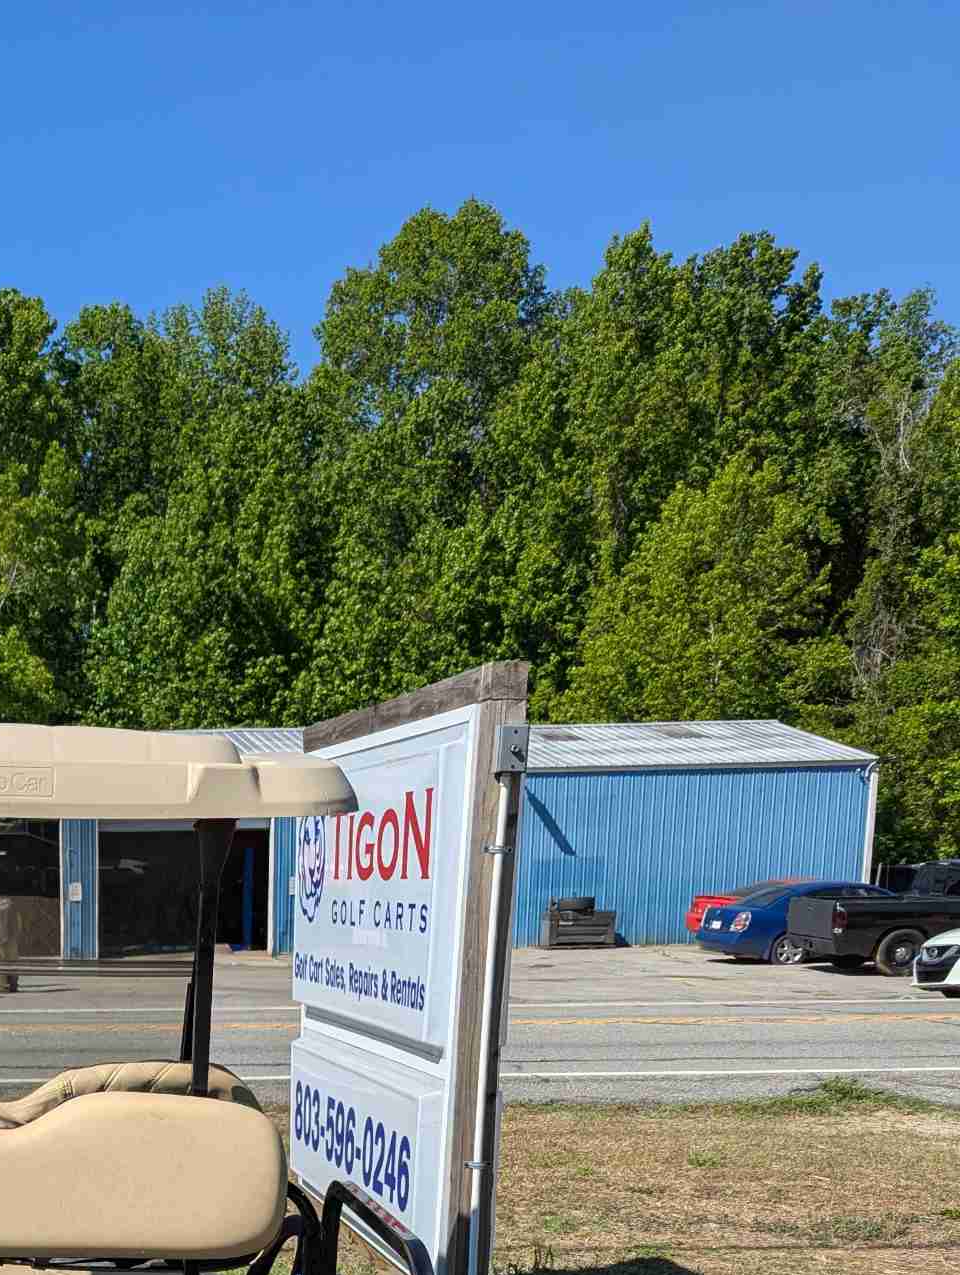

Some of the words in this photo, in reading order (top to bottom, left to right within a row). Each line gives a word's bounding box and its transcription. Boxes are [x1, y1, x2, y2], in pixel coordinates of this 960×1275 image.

[11, 771, 48, 793] Car
[332, 787, 434, 881] TIGON
[331, 900, 366, 927] GOLF
[373, 901, 429, 933] CARTS
[294, 952, 307, 981] Golf
[309, 955, 323, 985] Cart
[325, 957, 346, 994] Sales,
[349, 962, 378, 1000] Repairs
[381, 968, 388, 1000] &
[390, 970, 425, 1011] Rentals
[295, 1079, 411, 1213] 803-596-0246
